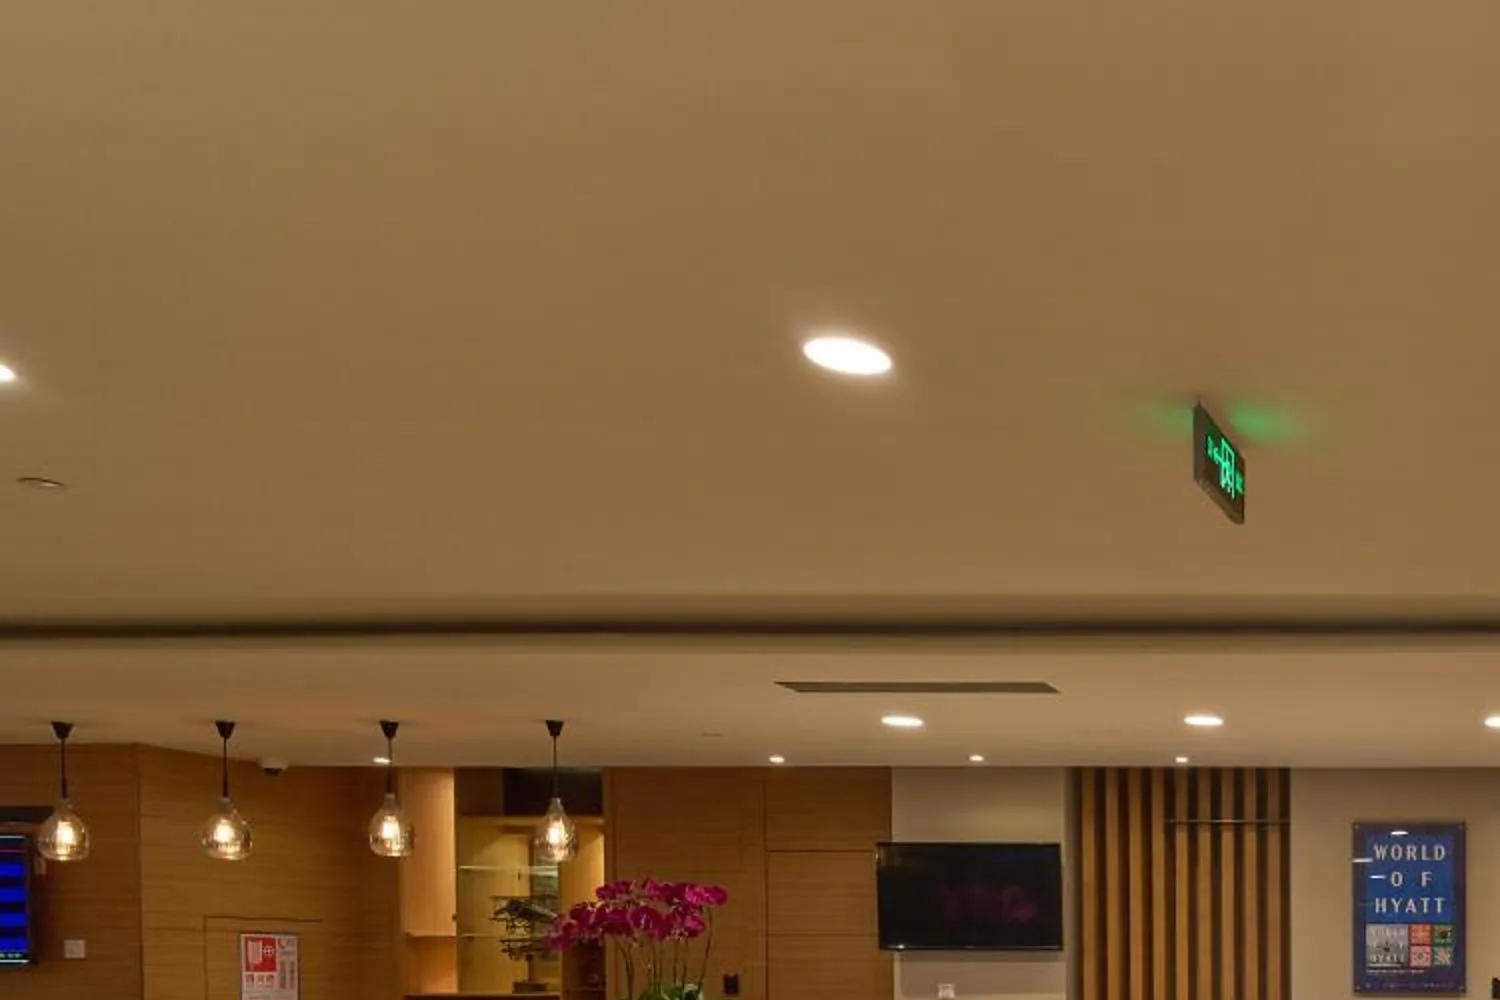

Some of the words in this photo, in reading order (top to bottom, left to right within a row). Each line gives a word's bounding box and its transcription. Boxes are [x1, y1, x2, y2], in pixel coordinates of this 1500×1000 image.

[1373, 843, 1446, 861] WORLD
[1391, 871, 1433, 888] OF
[1375, 896, 1446, 913] HYATT
